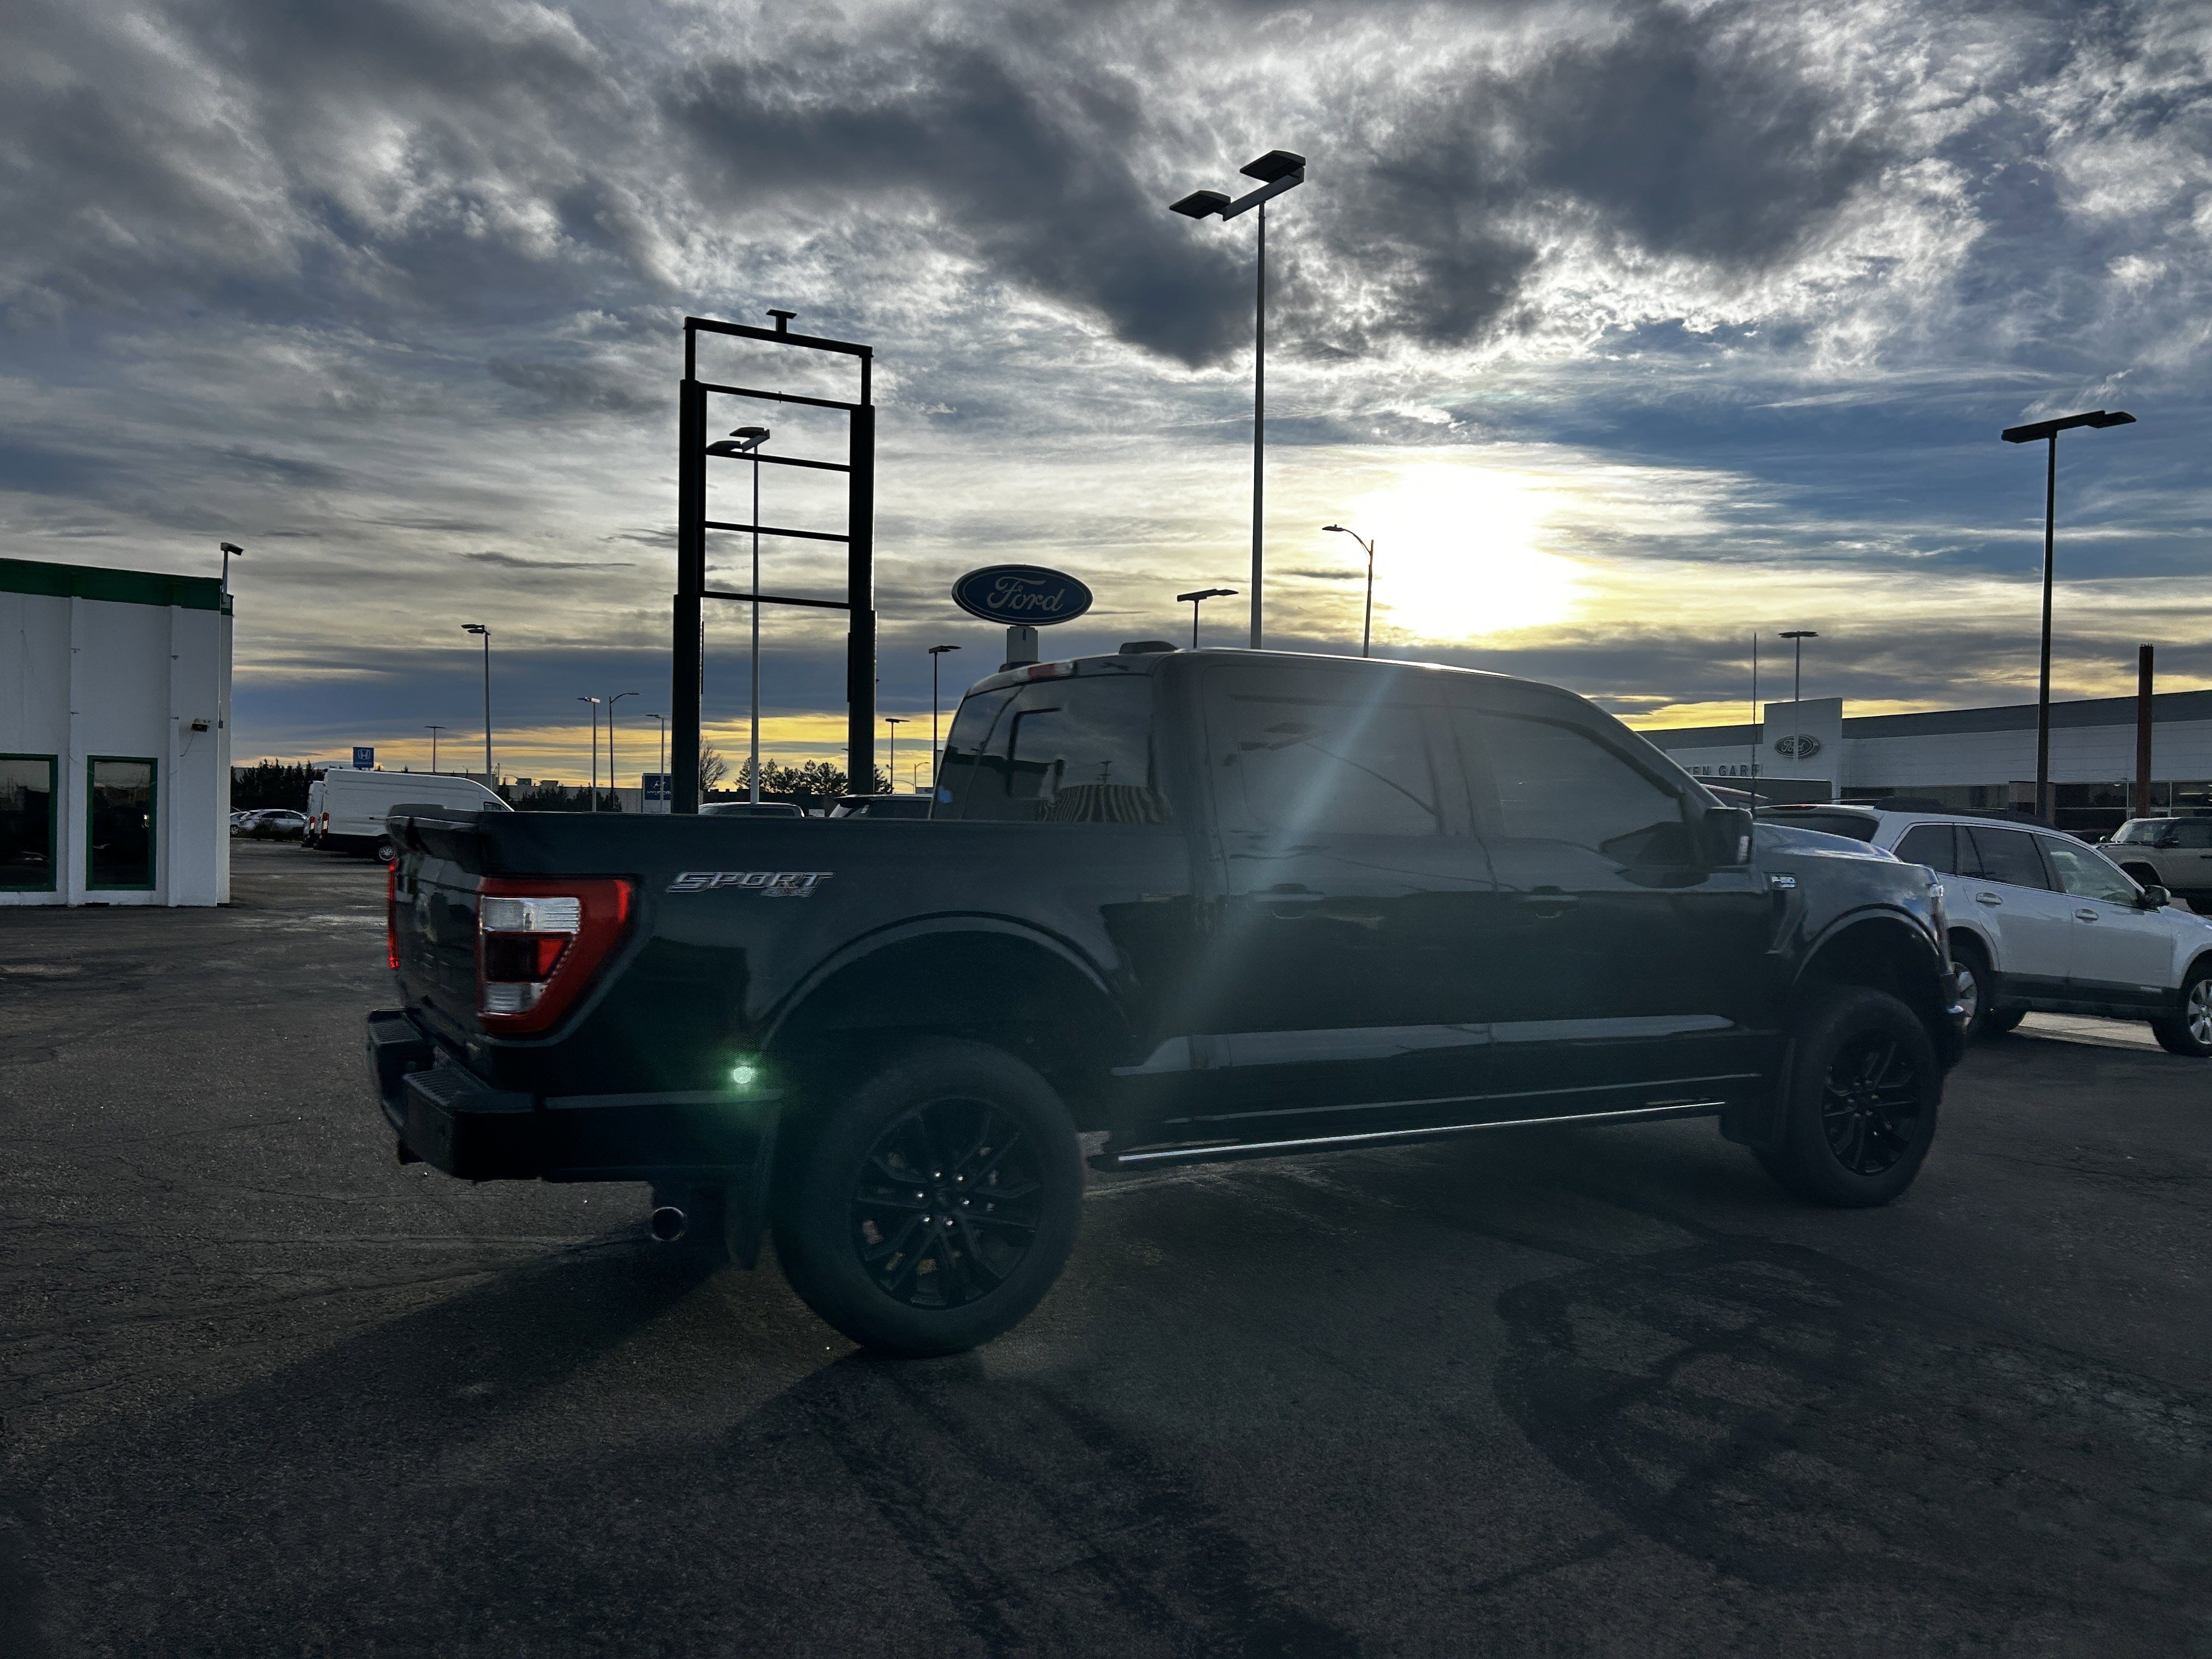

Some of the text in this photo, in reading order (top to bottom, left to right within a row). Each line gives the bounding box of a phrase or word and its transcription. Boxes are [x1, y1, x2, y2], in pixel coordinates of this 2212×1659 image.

[988, 577, 1065, 611] Ford
[1781, 740, 1805, 752] Fod
[1719, 765, 1763, 777] GARF
[666, 871, 836, 893] SPORT
